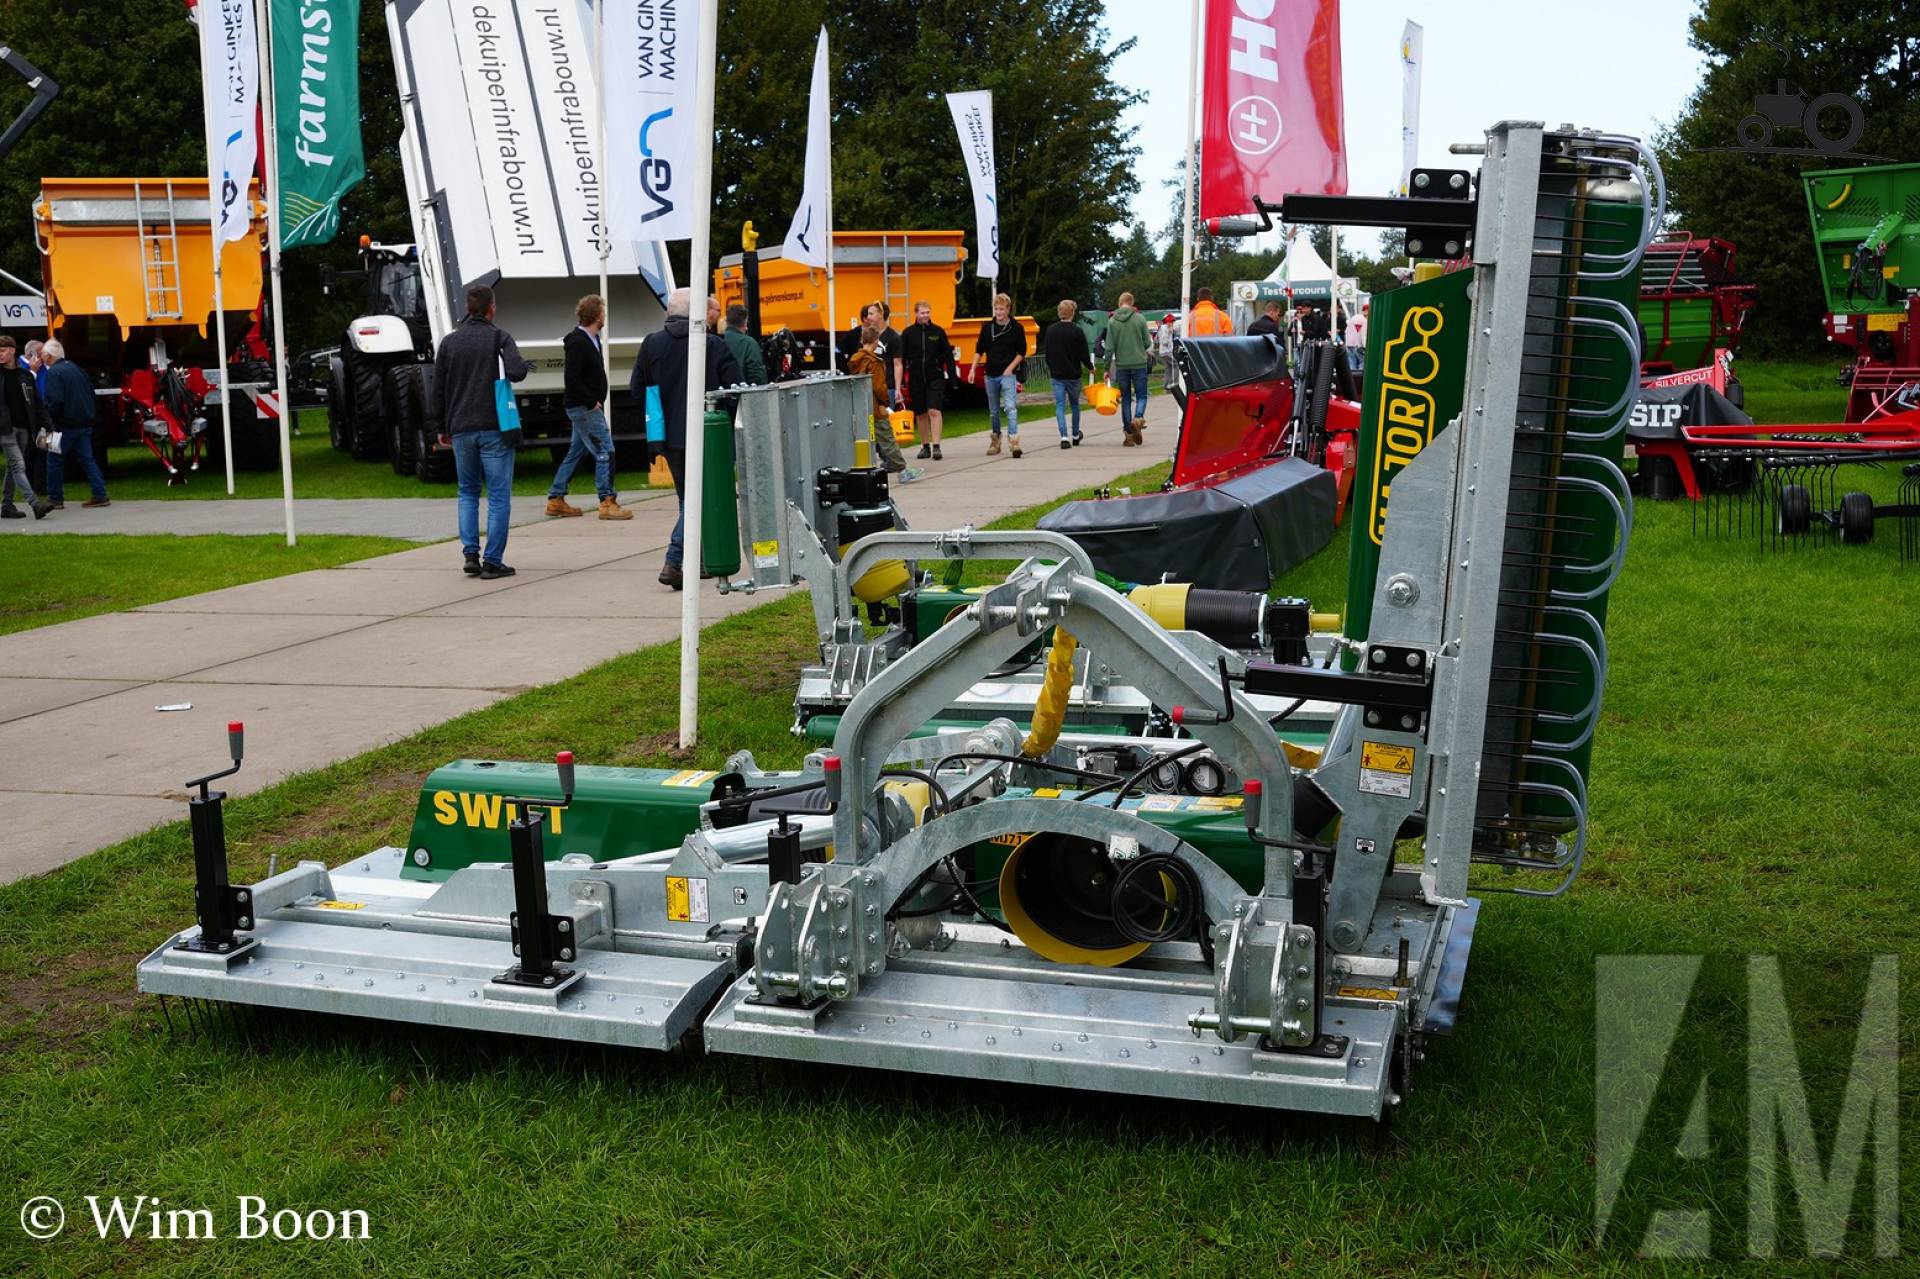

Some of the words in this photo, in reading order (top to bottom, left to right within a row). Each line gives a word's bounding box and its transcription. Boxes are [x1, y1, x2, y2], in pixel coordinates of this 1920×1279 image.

[638, 36, 654, 79] VAN
[295, 0, 333, 167] farms
[472, 4, 544, 256] dekuiperinfrabouw.nl
[1655, 370, 1713, 388] SILVERCUT
[433, 790, 569, 834] SWIT
